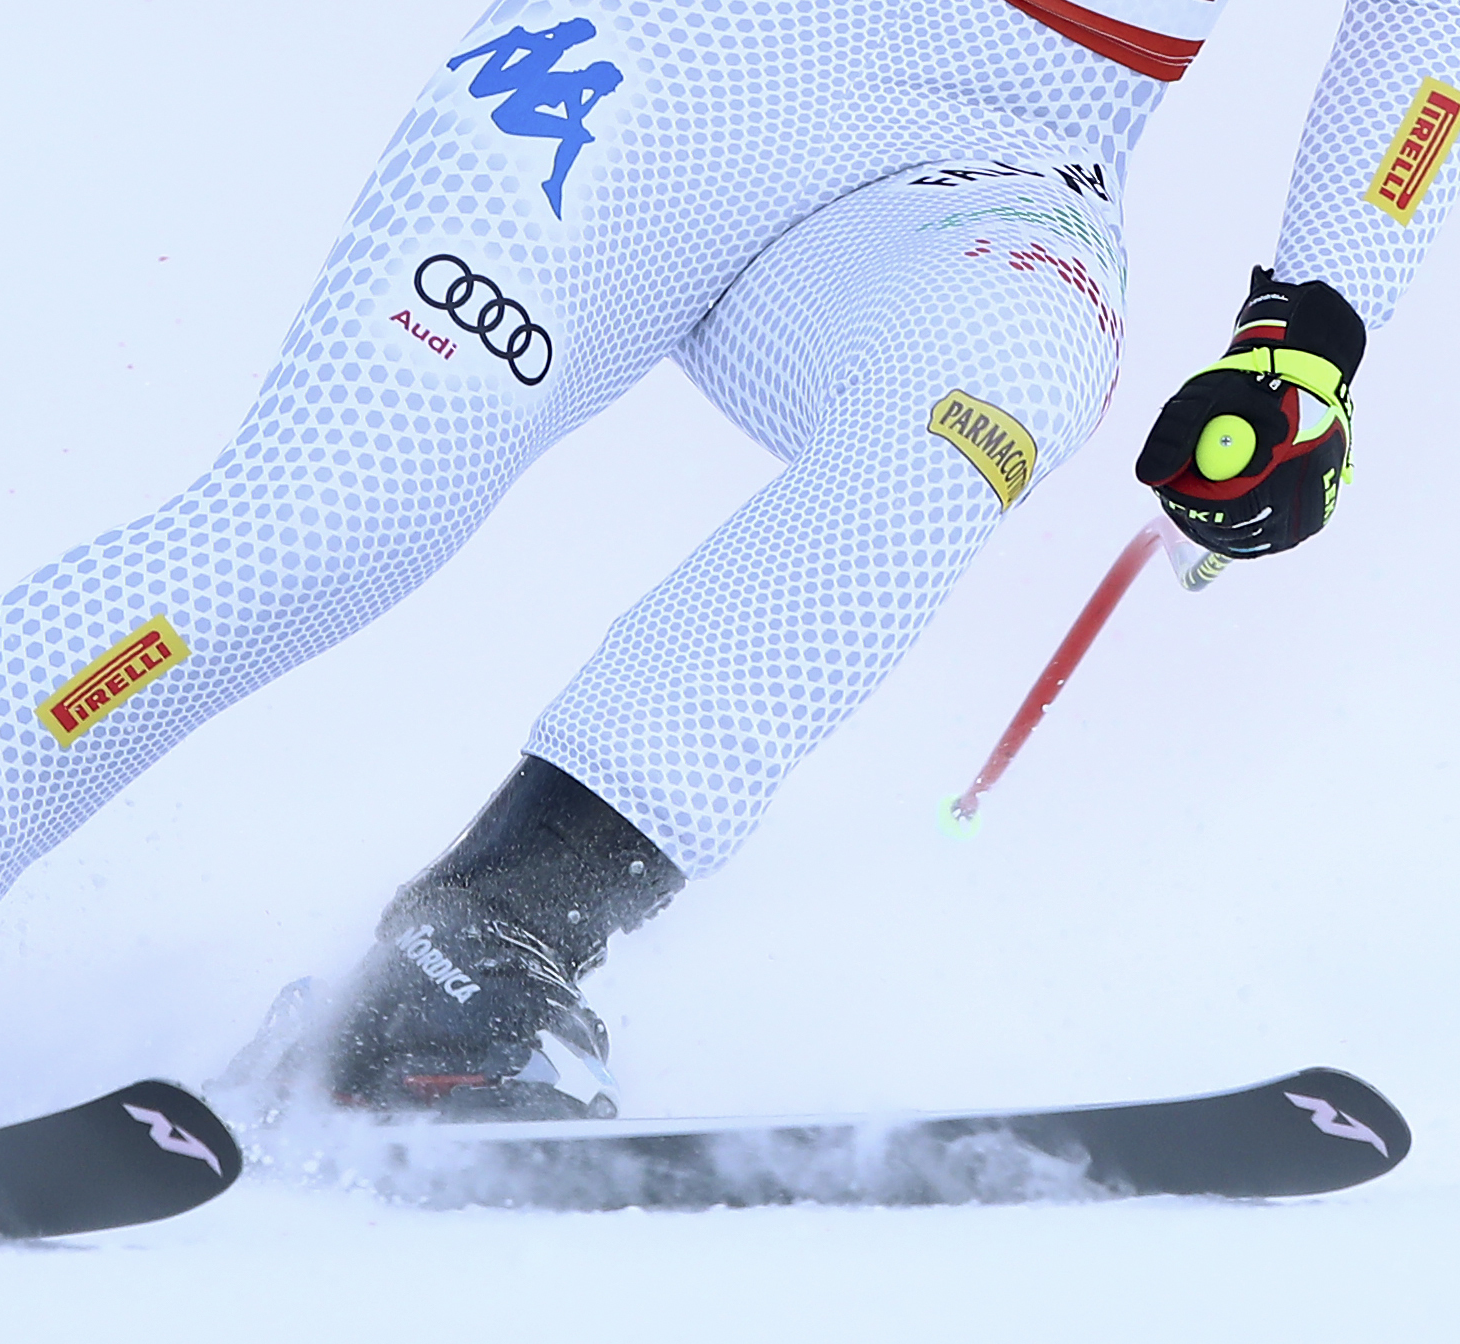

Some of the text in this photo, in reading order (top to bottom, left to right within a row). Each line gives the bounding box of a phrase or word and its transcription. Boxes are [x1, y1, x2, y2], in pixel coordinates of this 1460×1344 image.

[1378, 90, 1460, 211] PIRELLI
[389, 309, 458, 360] Audi
[50, 630, 172, 733] PIRELLI
